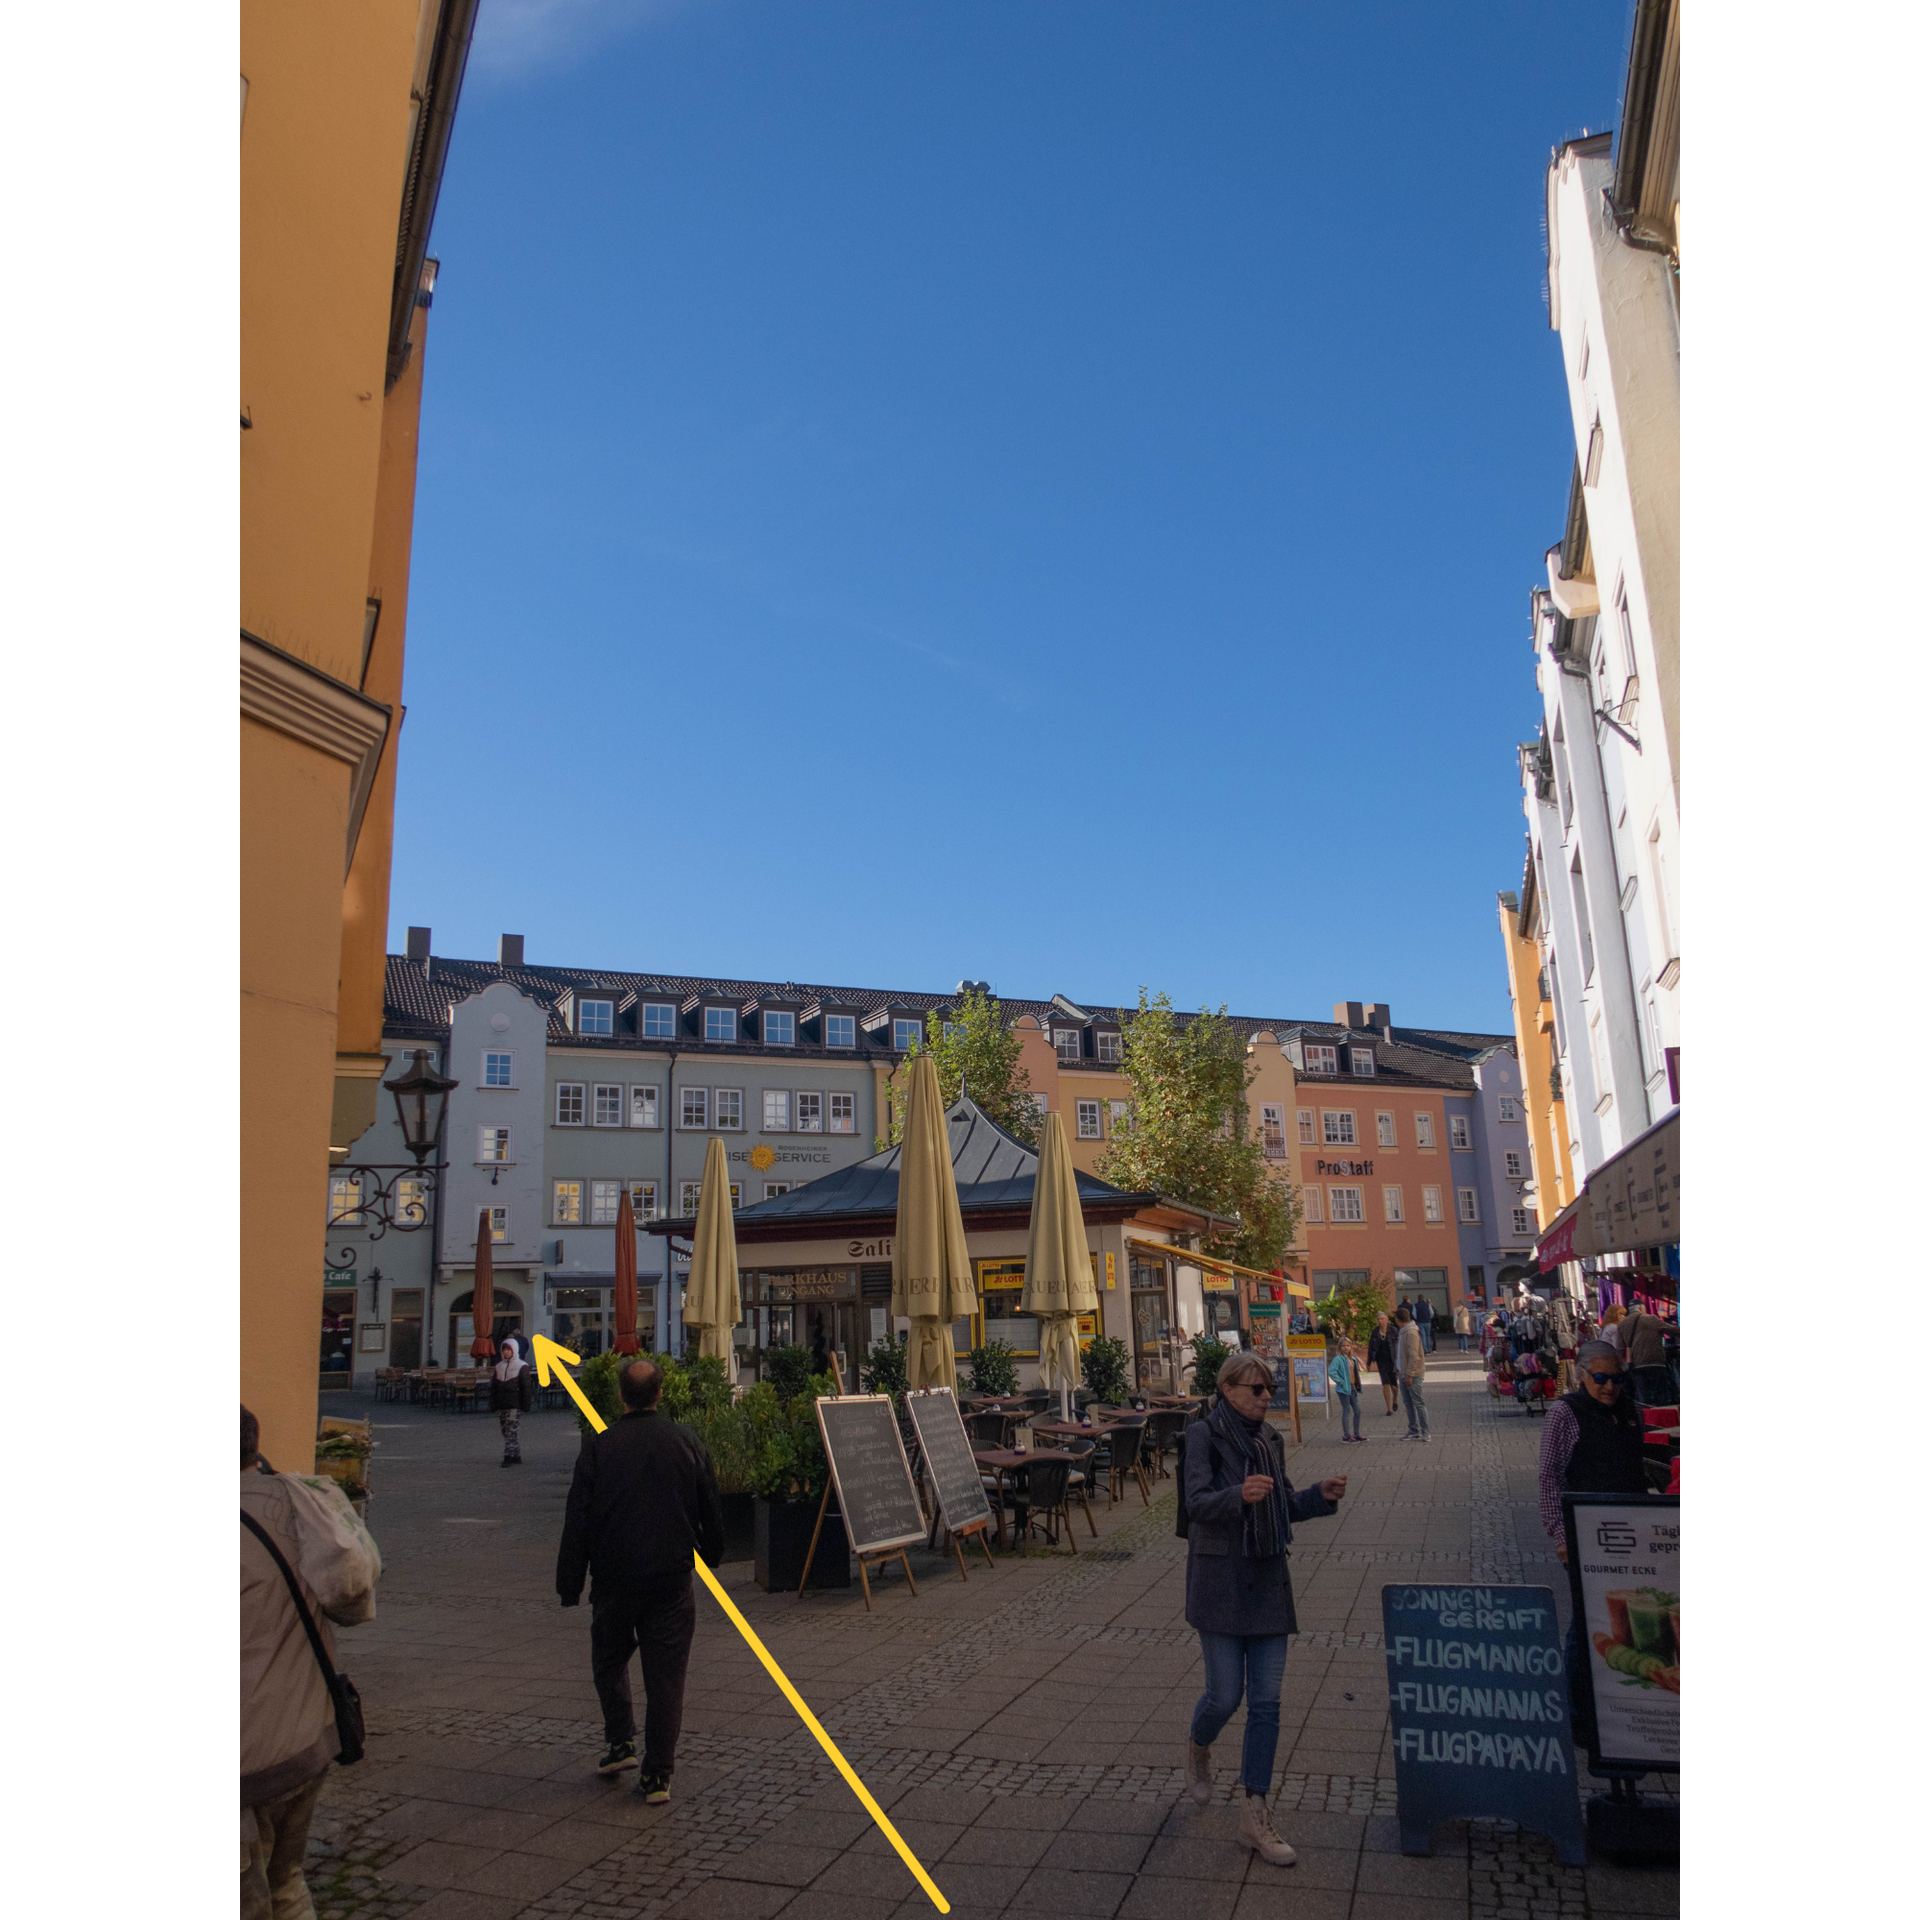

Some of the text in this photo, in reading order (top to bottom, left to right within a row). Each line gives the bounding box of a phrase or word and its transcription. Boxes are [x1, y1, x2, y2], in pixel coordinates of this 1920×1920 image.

[725, 1151, 831, 1163] ISE SERVICE
[1316, 1159, 1374, 1176] ProStaff
[847, 1239, 896, 1258] Sali
[768, 1272, 847, 1286] PARKHAUS
[778, 1285, 835, 1297] EINGANG
[1649, 1542, 1682, 1554] gepr
[1583, 1564, 1658, 1575] GOURMET ECKE
[1391, 1588, 1507, 1611] SONNEN-
[1438, 1608, 1548, 1631] GEREIFT
